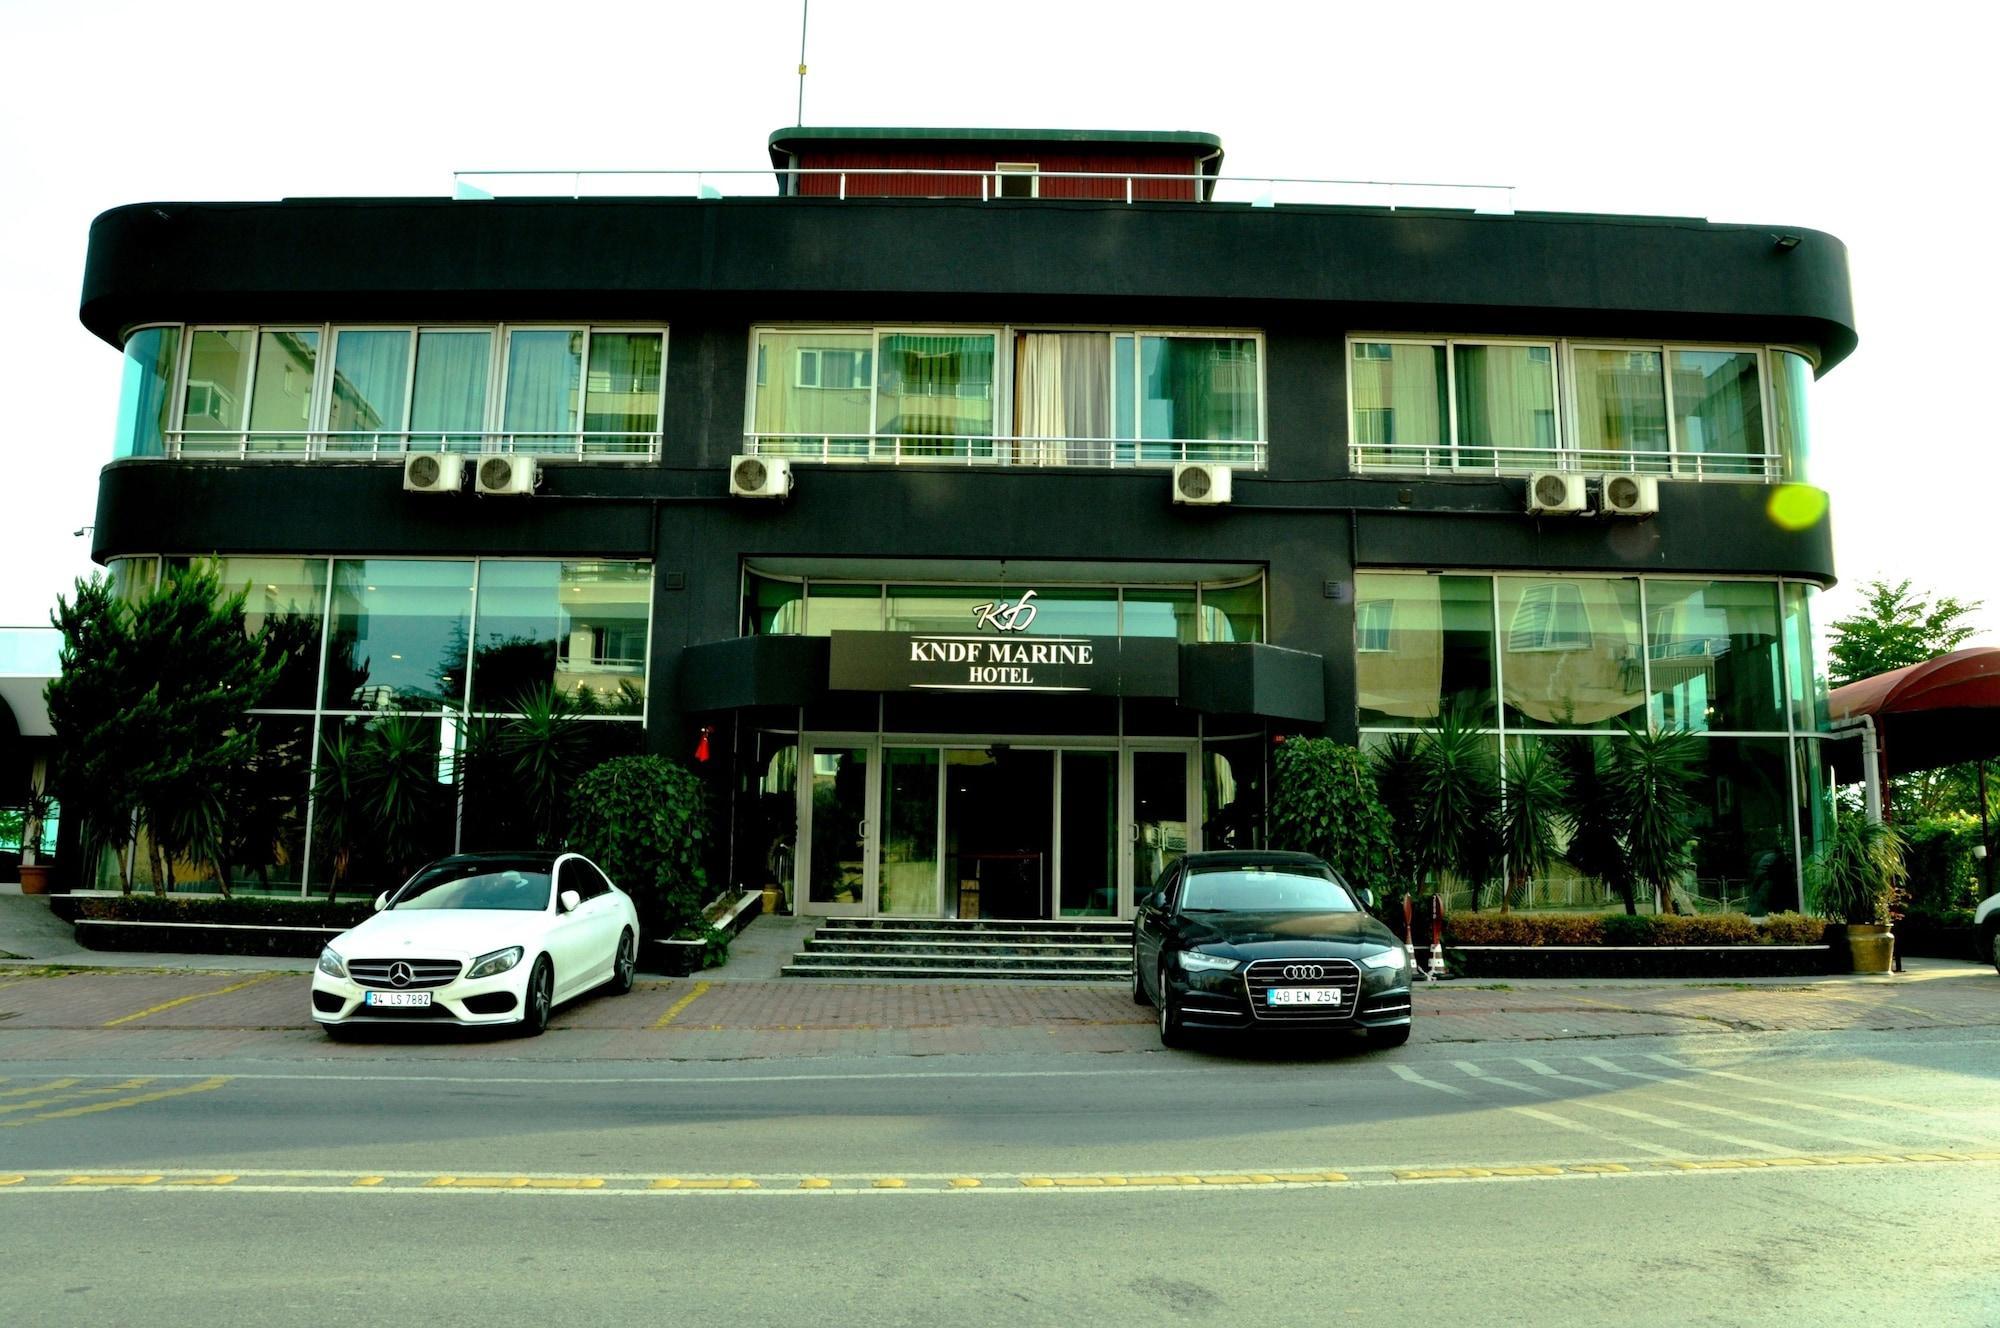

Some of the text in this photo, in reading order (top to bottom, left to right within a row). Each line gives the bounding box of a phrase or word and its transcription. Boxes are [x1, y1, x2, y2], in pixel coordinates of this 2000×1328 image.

[910, 641, 1094, 665] KNDF MARINE
[969, 666, 1034, 684] HOTEL
[373, 994, 429, 1005] 34 LS 7882
[1275, 991, 1338, 1002] 48 EN 254
